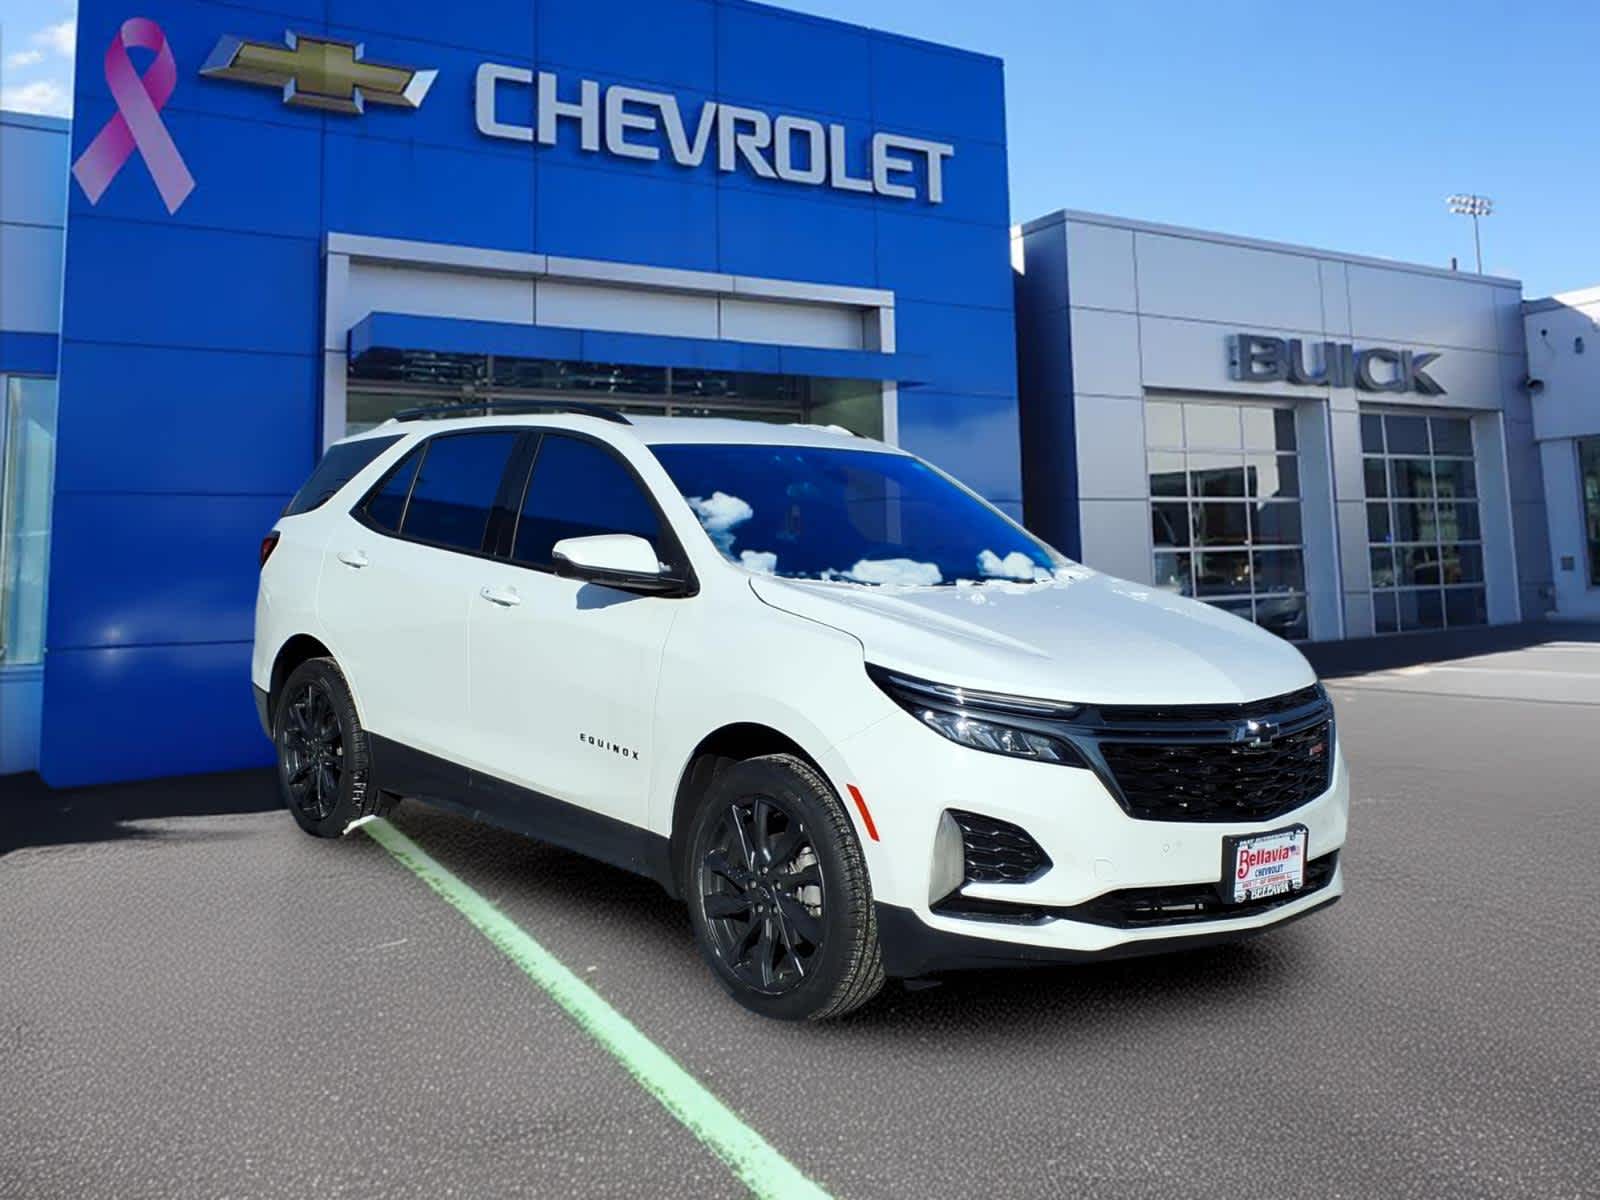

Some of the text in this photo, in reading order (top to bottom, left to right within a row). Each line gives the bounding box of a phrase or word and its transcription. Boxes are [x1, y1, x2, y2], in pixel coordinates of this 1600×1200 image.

[475, 62, 955, 204] CHEVROLET
[1225, 333, 1448, 395] BUICK
[580, 732, 638, 760] EQUINOX
[1238, 845, 1289, 879] Bellavia
